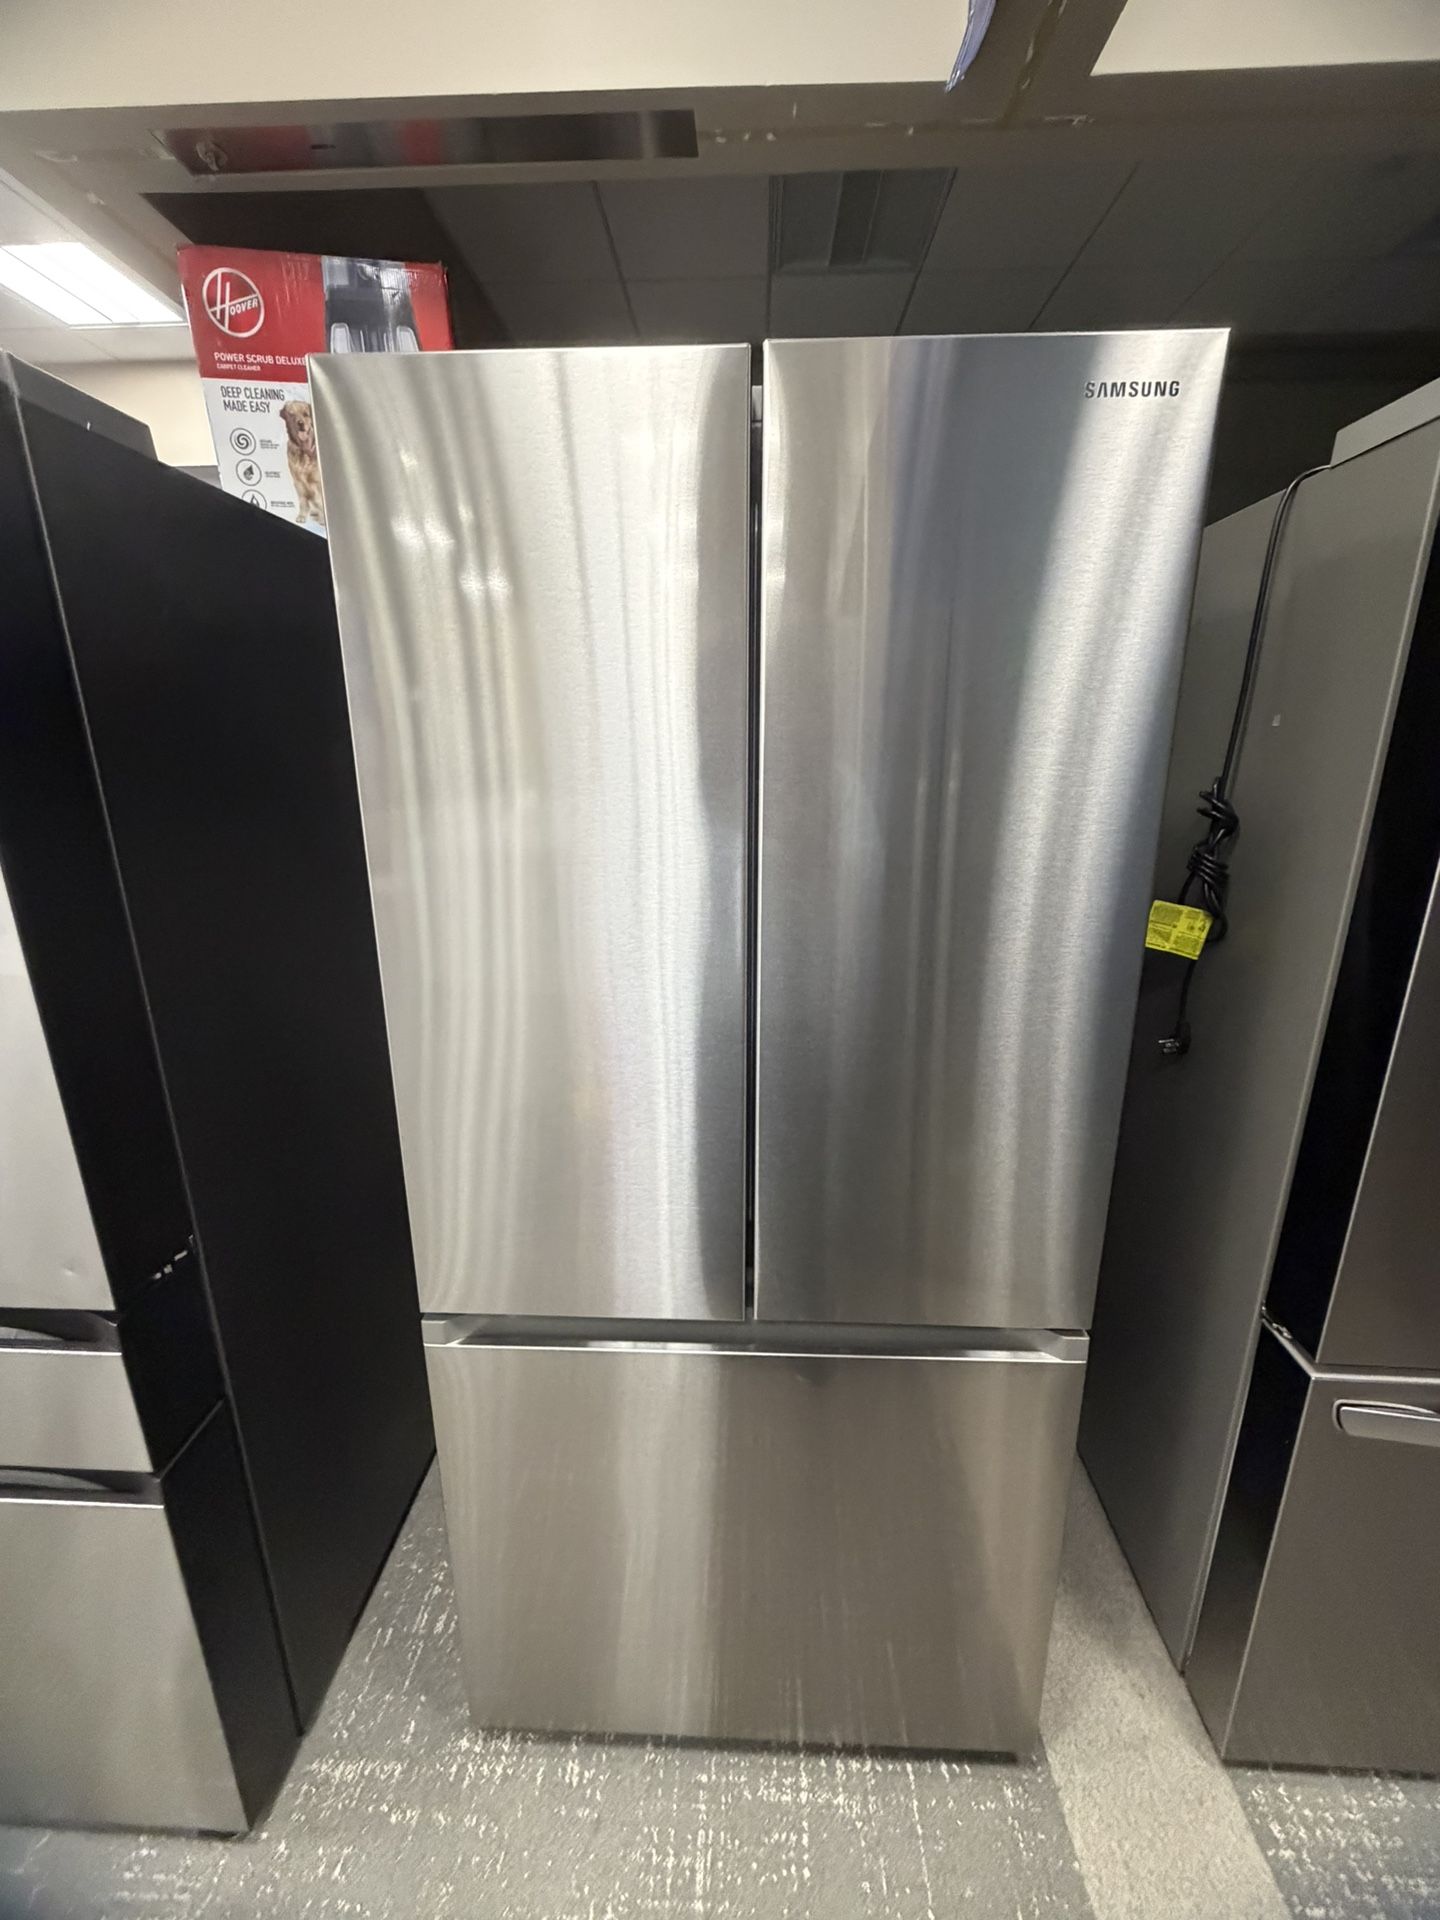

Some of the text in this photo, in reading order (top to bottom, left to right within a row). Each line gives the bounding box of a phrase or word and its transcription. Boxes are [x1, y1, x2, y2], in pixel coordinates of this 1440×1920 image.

[208, 268, 260, 333] HOOVER
[214, 352, 245, 362] POWER
[245, 354, 274, 364] SCRUB
[220, 386, 285, 401] DEEP CLEANING
[1085, 381, 1180, 399] SAMSUNG
[223, 400, 270, 413] MADE EASY
